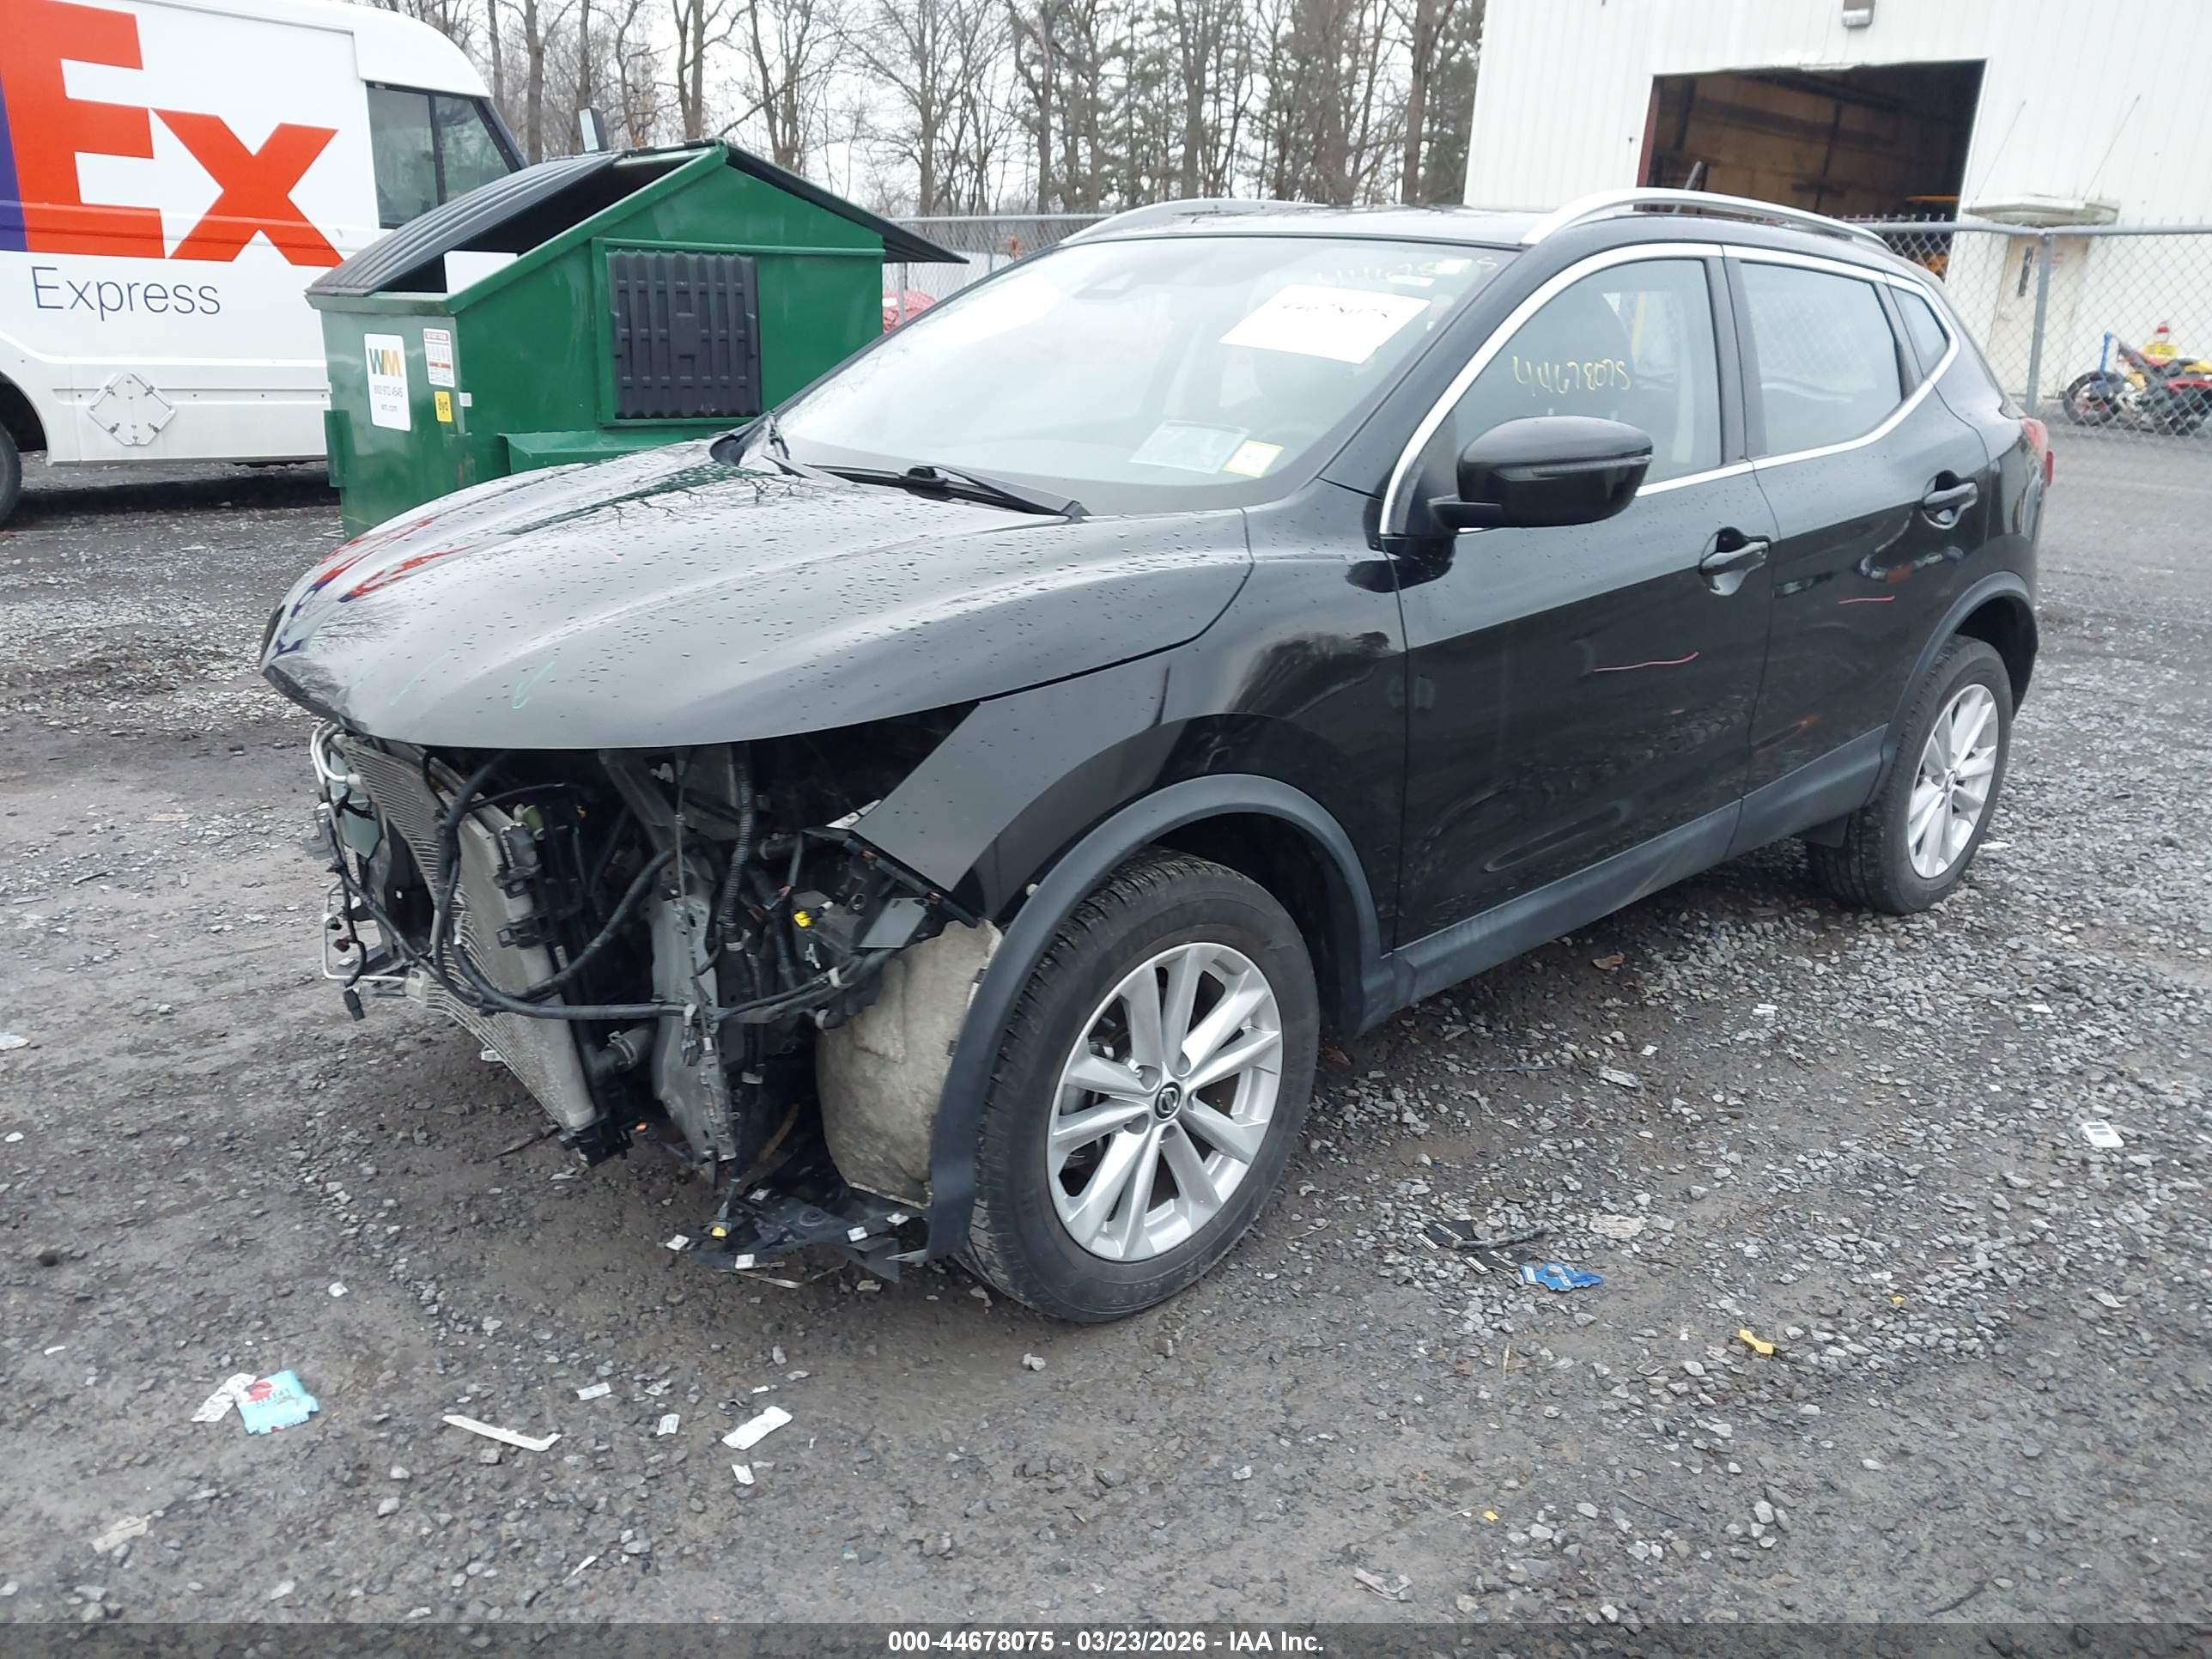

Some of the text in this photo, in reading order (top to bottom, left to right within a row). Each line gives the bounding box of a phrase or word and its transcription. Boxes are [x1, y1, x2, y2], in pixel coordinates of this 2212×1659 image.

[0, 0, 344, 269] Ex
[31, 265, 222, 322] Express
[368, 348, 403, 377] WM
[1512, 356, 1632, 397] 44678075
